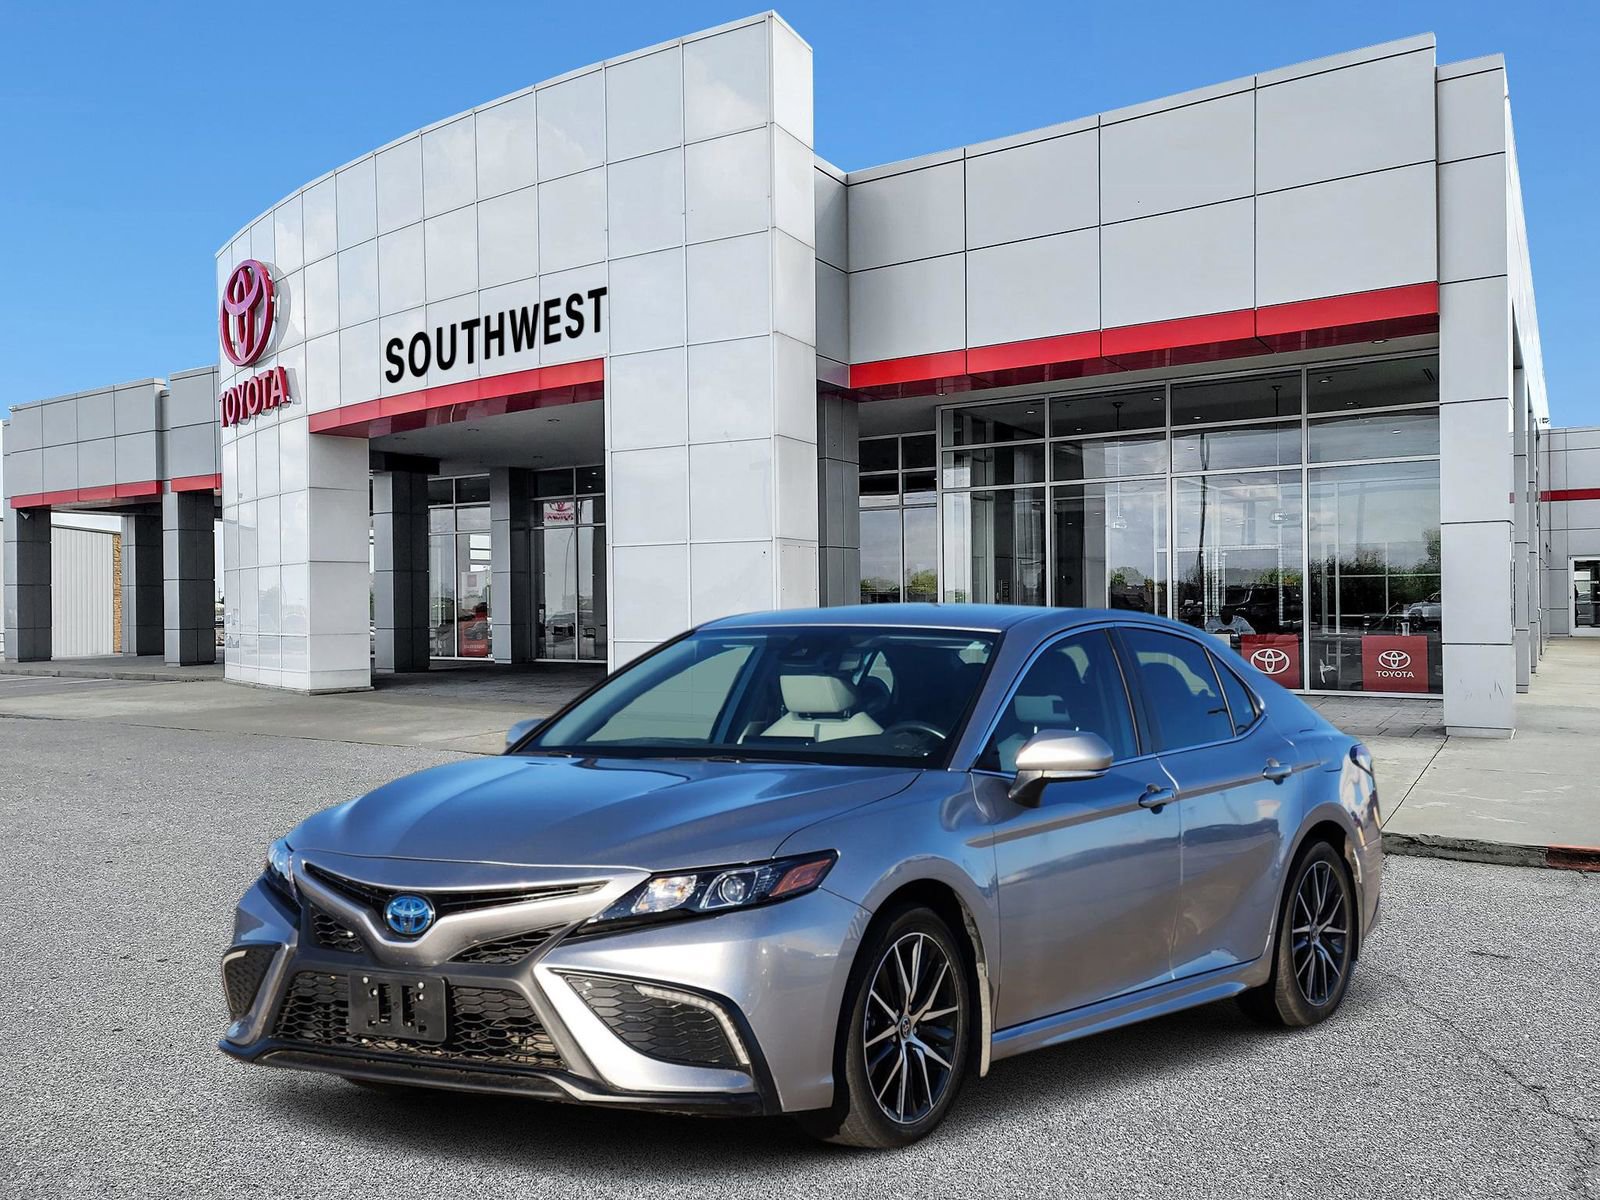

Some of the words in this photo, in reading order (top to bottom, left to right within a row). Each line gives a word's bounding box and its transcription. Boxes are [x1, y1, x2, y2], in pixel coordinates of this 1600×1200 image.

[385, 286, 608, 384] SOUTHWEST
[219, 366, 289, 427] TOYOTA
[1376, 670, 1415, 678] TOYOTA
